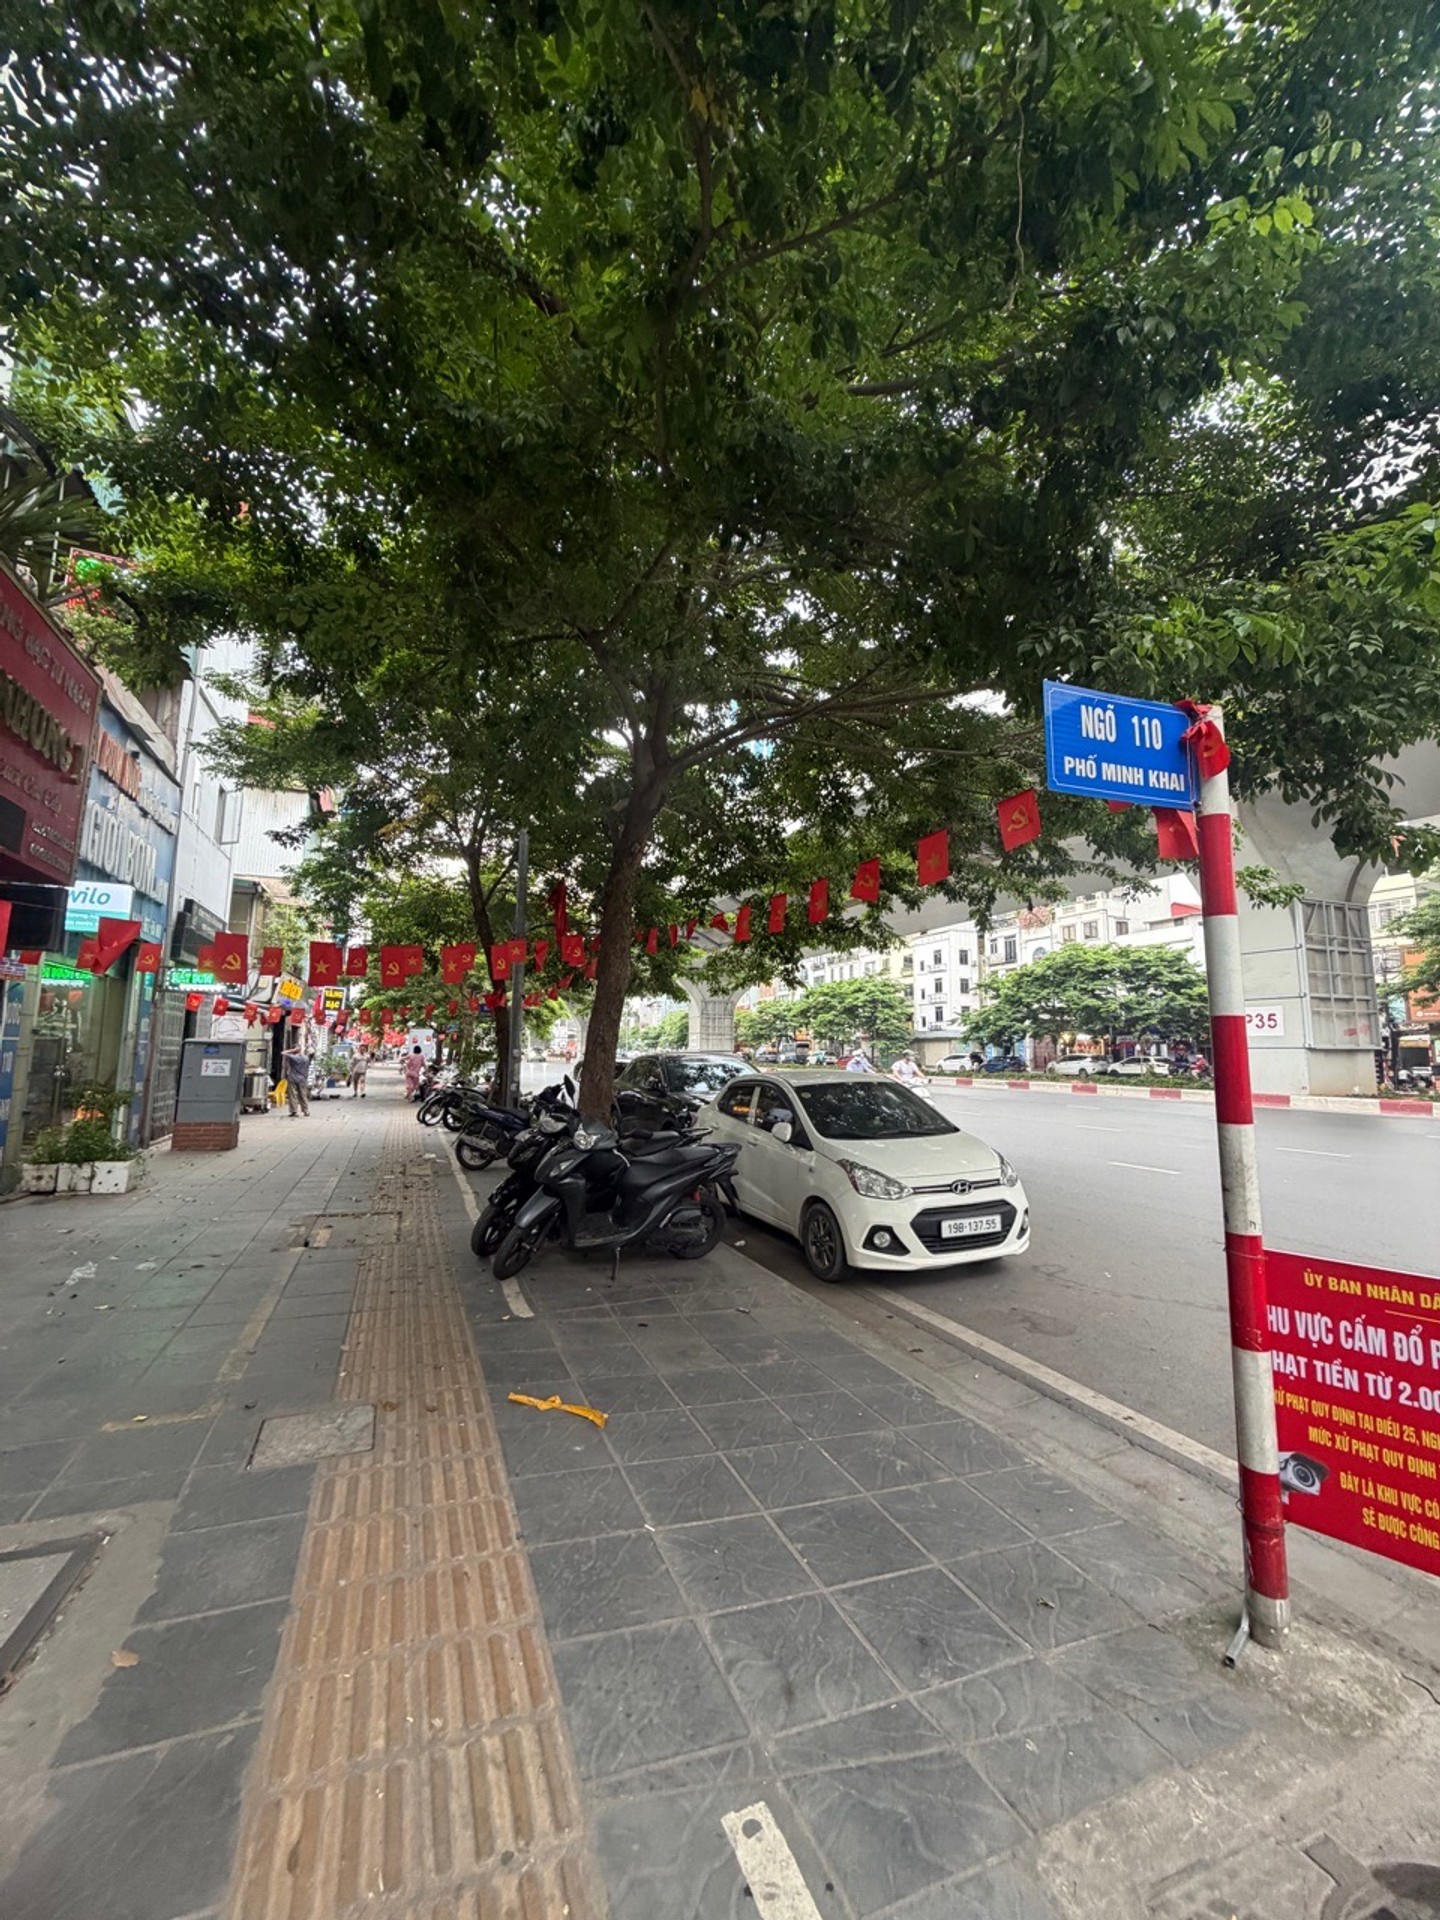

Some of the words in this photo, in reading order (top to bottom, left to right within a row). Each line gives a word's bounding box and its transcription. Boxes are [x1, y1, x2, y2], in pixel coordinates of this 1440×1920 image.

[1080, 704, 1117, 743] NGÕ
[1131, 715, 1163, 750] 110
[1064, 754, 1098, 779] PHỐ
[1101, 762, 1144, 786] MINH
[1148, 769, 1186, 792] KHAI
[947, 1218, 997, 1234] 19B-137.55
[1304, 1268, 1323, 1289] ỦY
[1328, 1276, 1362, 1295] BAN
[1366, 1283, 1415, 1306] NHÂN
[1266, 1304, 1290, 1335] HU
[1294, 1310, 1334, 1348] VỰC
[1339, 1314, 1388, 1358] CẤM
[1393, 1324, 1424, 1366] ĐỔ
[1271, 1350, 1308, 1381] HẠT
[1313, 1358, 1360, 1393] TIỀN
[1364, 1371, 1393, 1400] TỪ
[1286, 1392, 1309, 1414] PHẠT
[1311, 1400, 1330, 1419] QUY
[1331, 1405, 1356, 1427] ĐỊNH
[1358, 1412, 1374, 1434] TẠI
[1402, 1424, 1420, 1447] 25,
[1308, 1425, 1332, 1447] MỨC
[1334, 1431, 1350, 1452] XỬ
[1351, 1438, 1379, 1463] PHẠT
[1382, 1448, 1404, 1469] QUY
[1407, 1454, 1437, 1480] ĐỊNH
[1339, 1471, 1359, 1493] ĐÂY
[1362, 1476, 1375, 1499] LÀ
[1377, 1483, 1398, 1507] KHU
[1401, 1489, 1423, 1516] VỰC
[1378, 1512, 1407, 1540] ĐƯỢC
[1409, 1522, 1440, 1550] CÔNG
